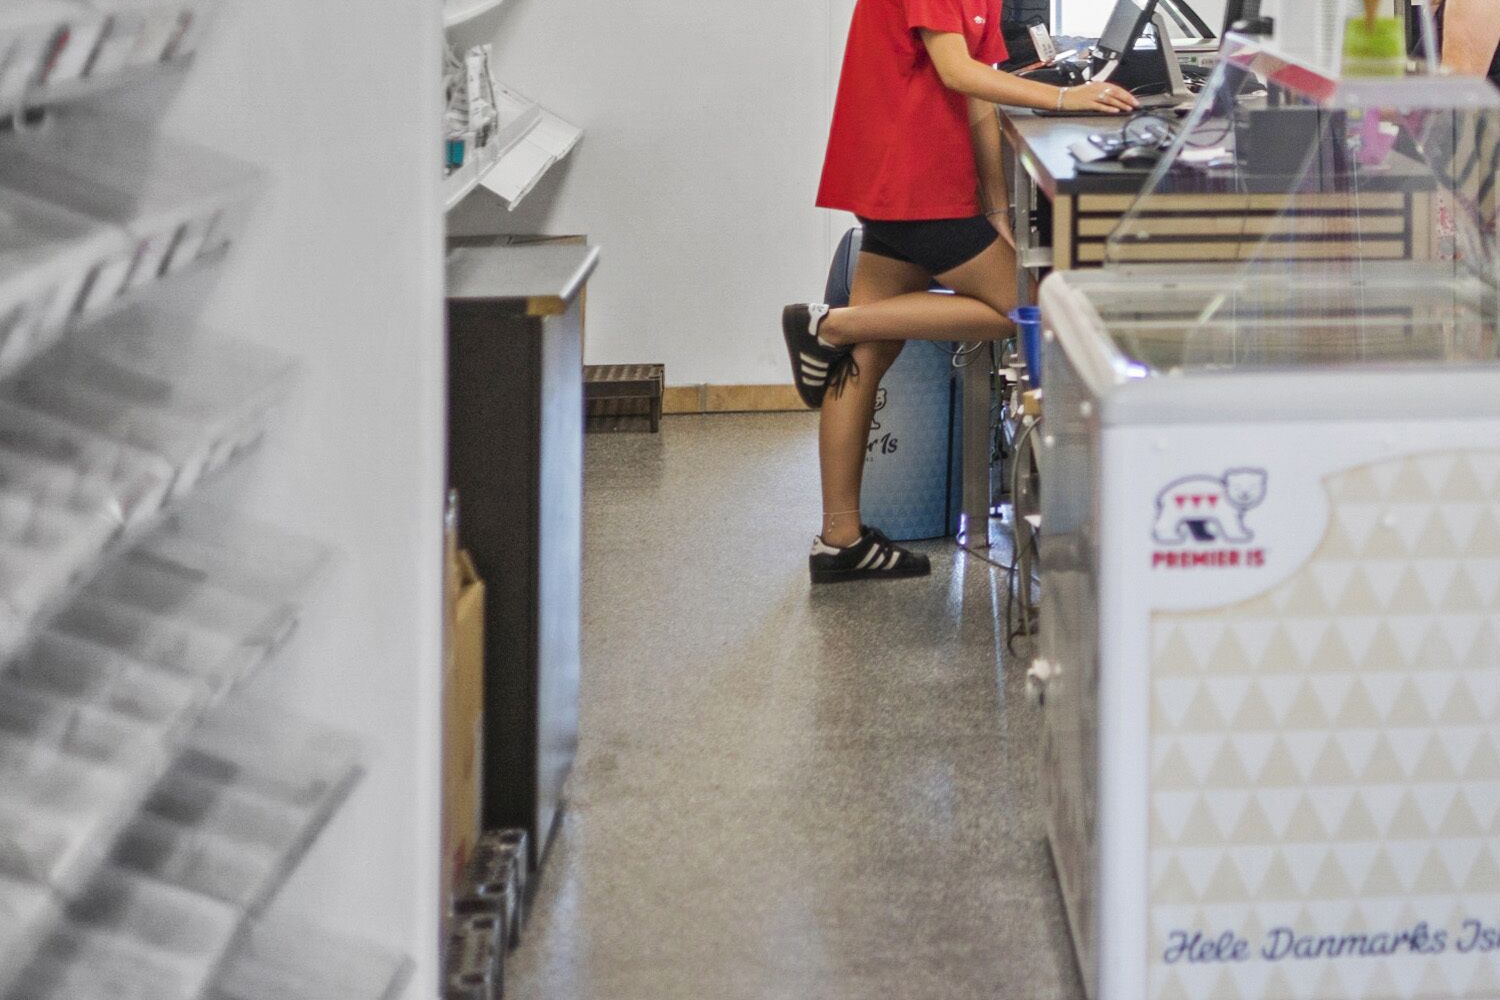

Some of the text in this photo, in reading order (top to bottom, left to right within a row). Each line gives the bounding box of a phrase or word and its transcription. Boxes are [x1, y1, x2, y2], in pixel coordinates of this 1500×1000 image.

[1151, 548, 1265, 568] PREMIER IS
[1164, 930, 1250, 963] Hele
[1259, 920, 1448, 961] Danmarks
